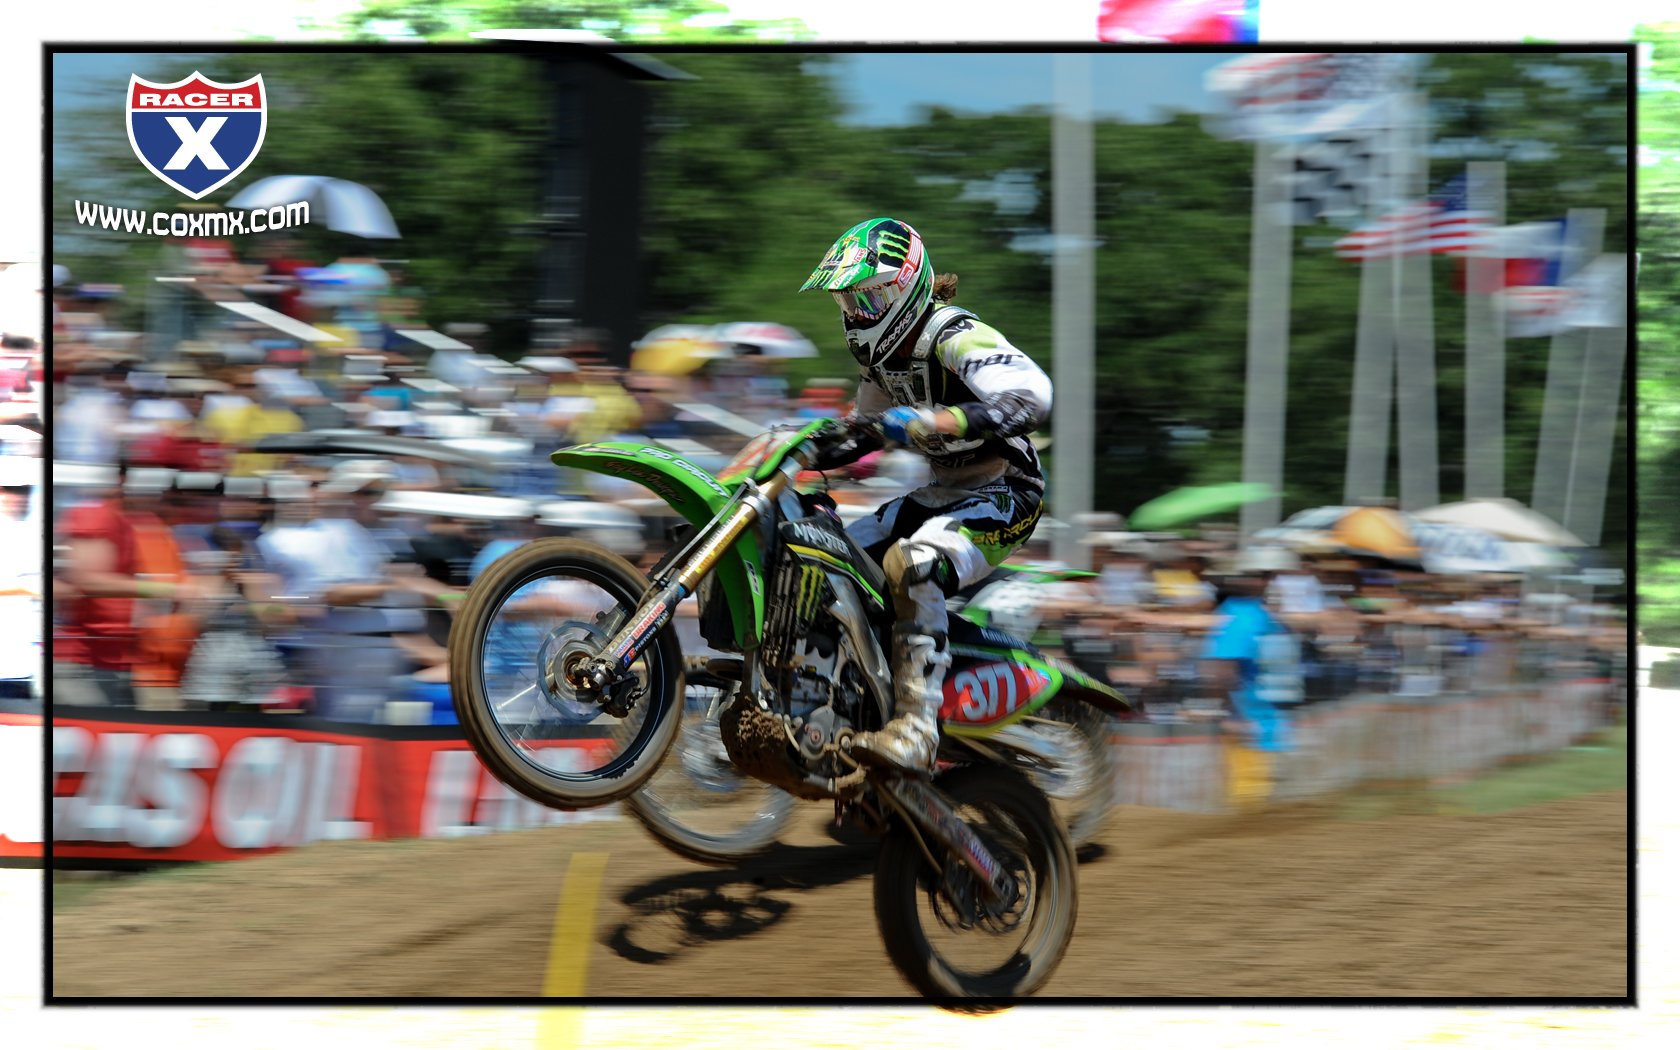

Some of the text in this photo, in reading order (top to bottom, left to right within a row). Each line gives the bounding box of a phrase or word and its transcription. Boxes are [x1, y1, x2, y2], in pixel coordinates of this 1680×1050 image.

[875, 310, 913, 354] TRAXXAS
[632, 602, 667, 640] BRAKING
[954, 661, 1017, 721] 377
